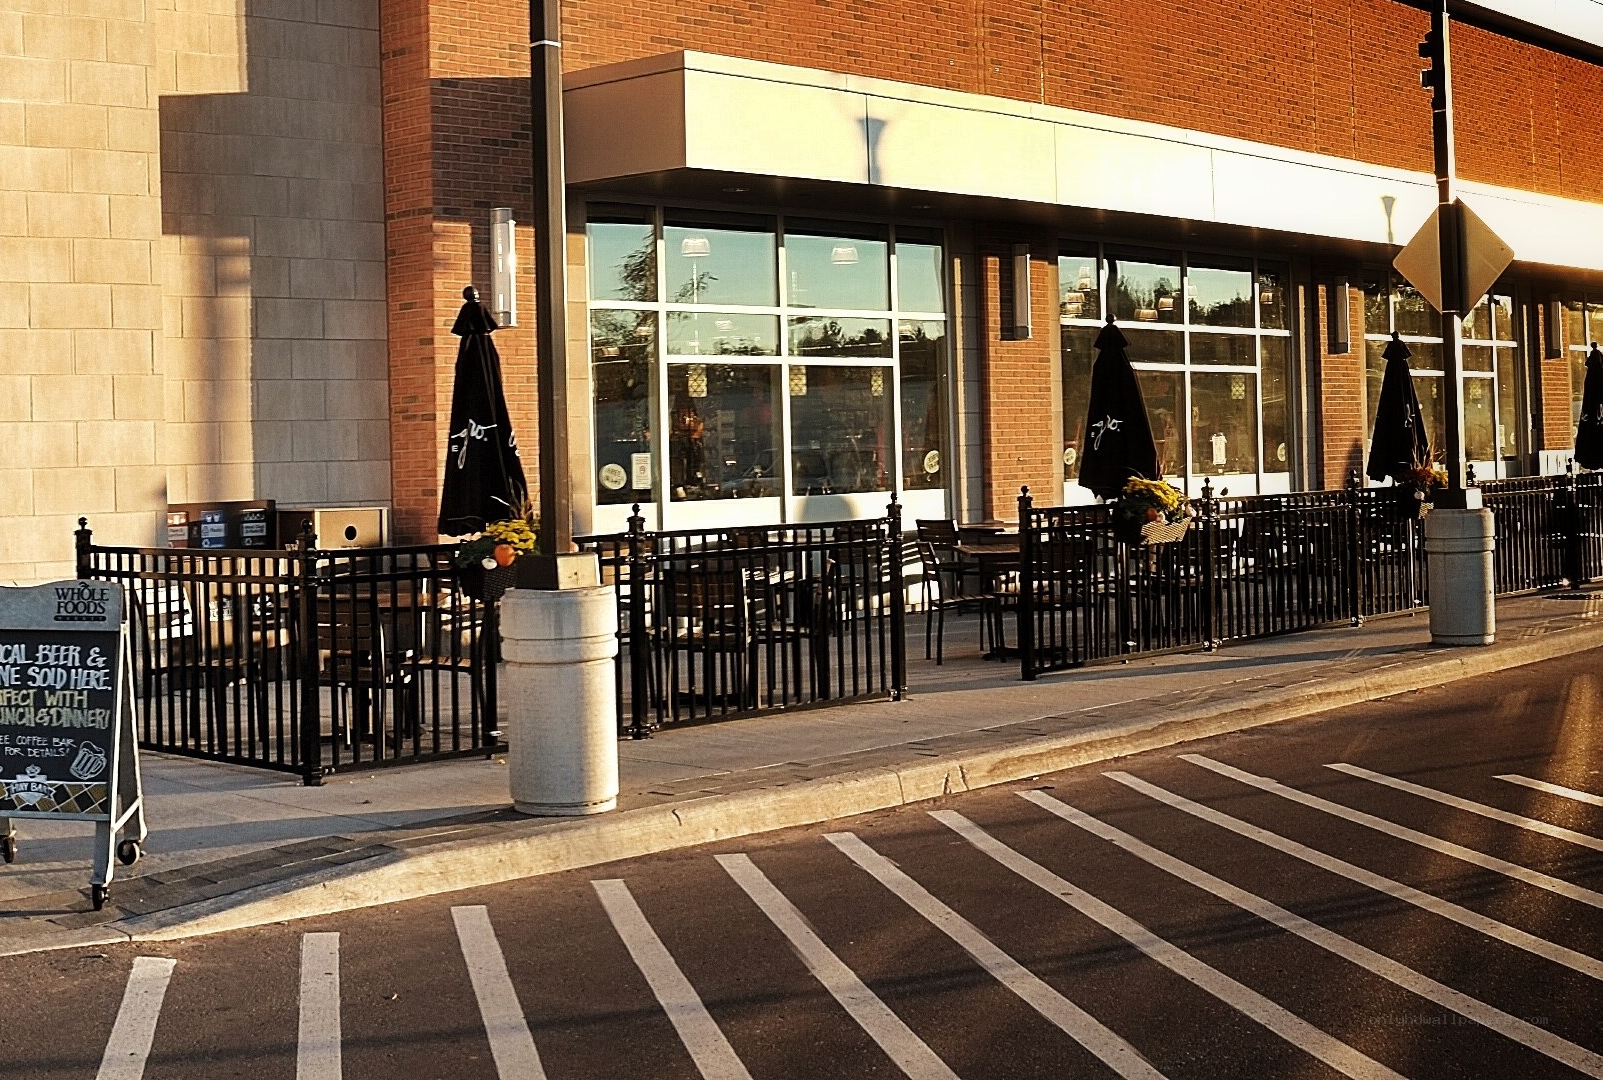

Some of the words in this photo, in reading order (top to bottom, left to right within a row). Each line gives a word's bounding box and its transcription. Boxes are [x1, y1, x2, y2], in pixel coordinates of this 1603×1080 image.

[55, 581, 109, 601] WHOLE
[57, 601, 105, 614] FOODS
[35, 644, 81, 667] BEER
[86, 647, 107, 668] &
[27, 666, 67, 690] SOLD
[44, 689, 88, 708] WITH
[50, 707, 111, 730] DINNER!
[15, 735, 49, 746] COFFEE
[53, 737, 78, 748] BAR
[4, 746, 25, 756] FOR
[27, 747, 70, 757] DETAILS!
